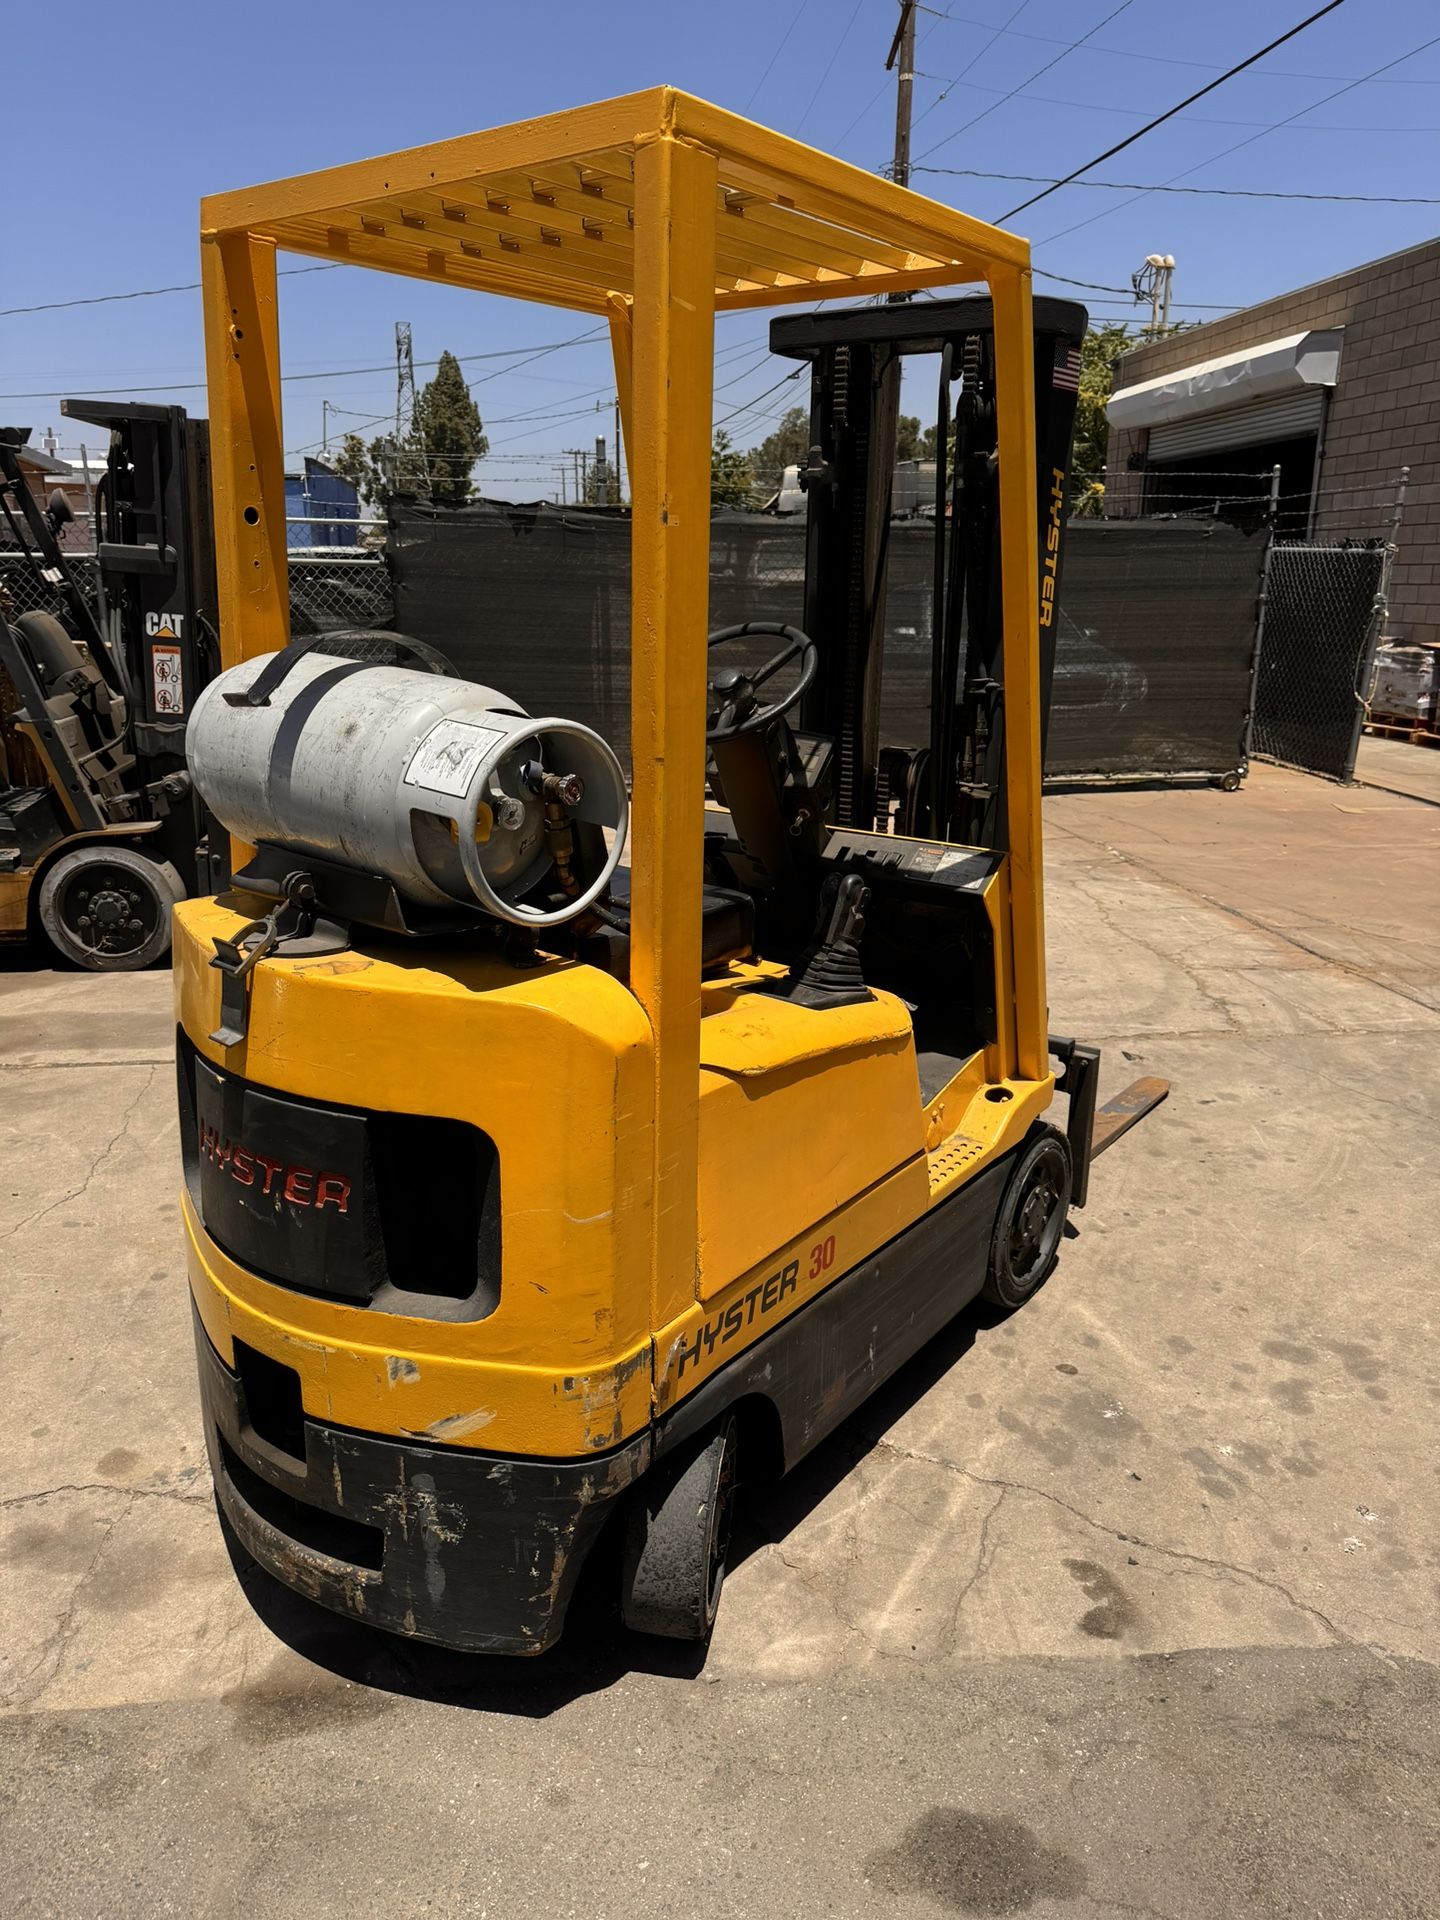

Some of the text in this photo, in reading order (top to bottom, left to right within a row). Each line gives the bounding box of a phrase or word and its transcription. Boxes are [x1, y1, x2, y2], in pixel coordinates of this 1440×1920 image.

[1039, 467, 1065, 628] HYSTER
[145, 611, 184, 639] CAT
[200, 1117, 351, 1213] HYSTER
[677, 1234, 836, 1379] HYSTER 30
